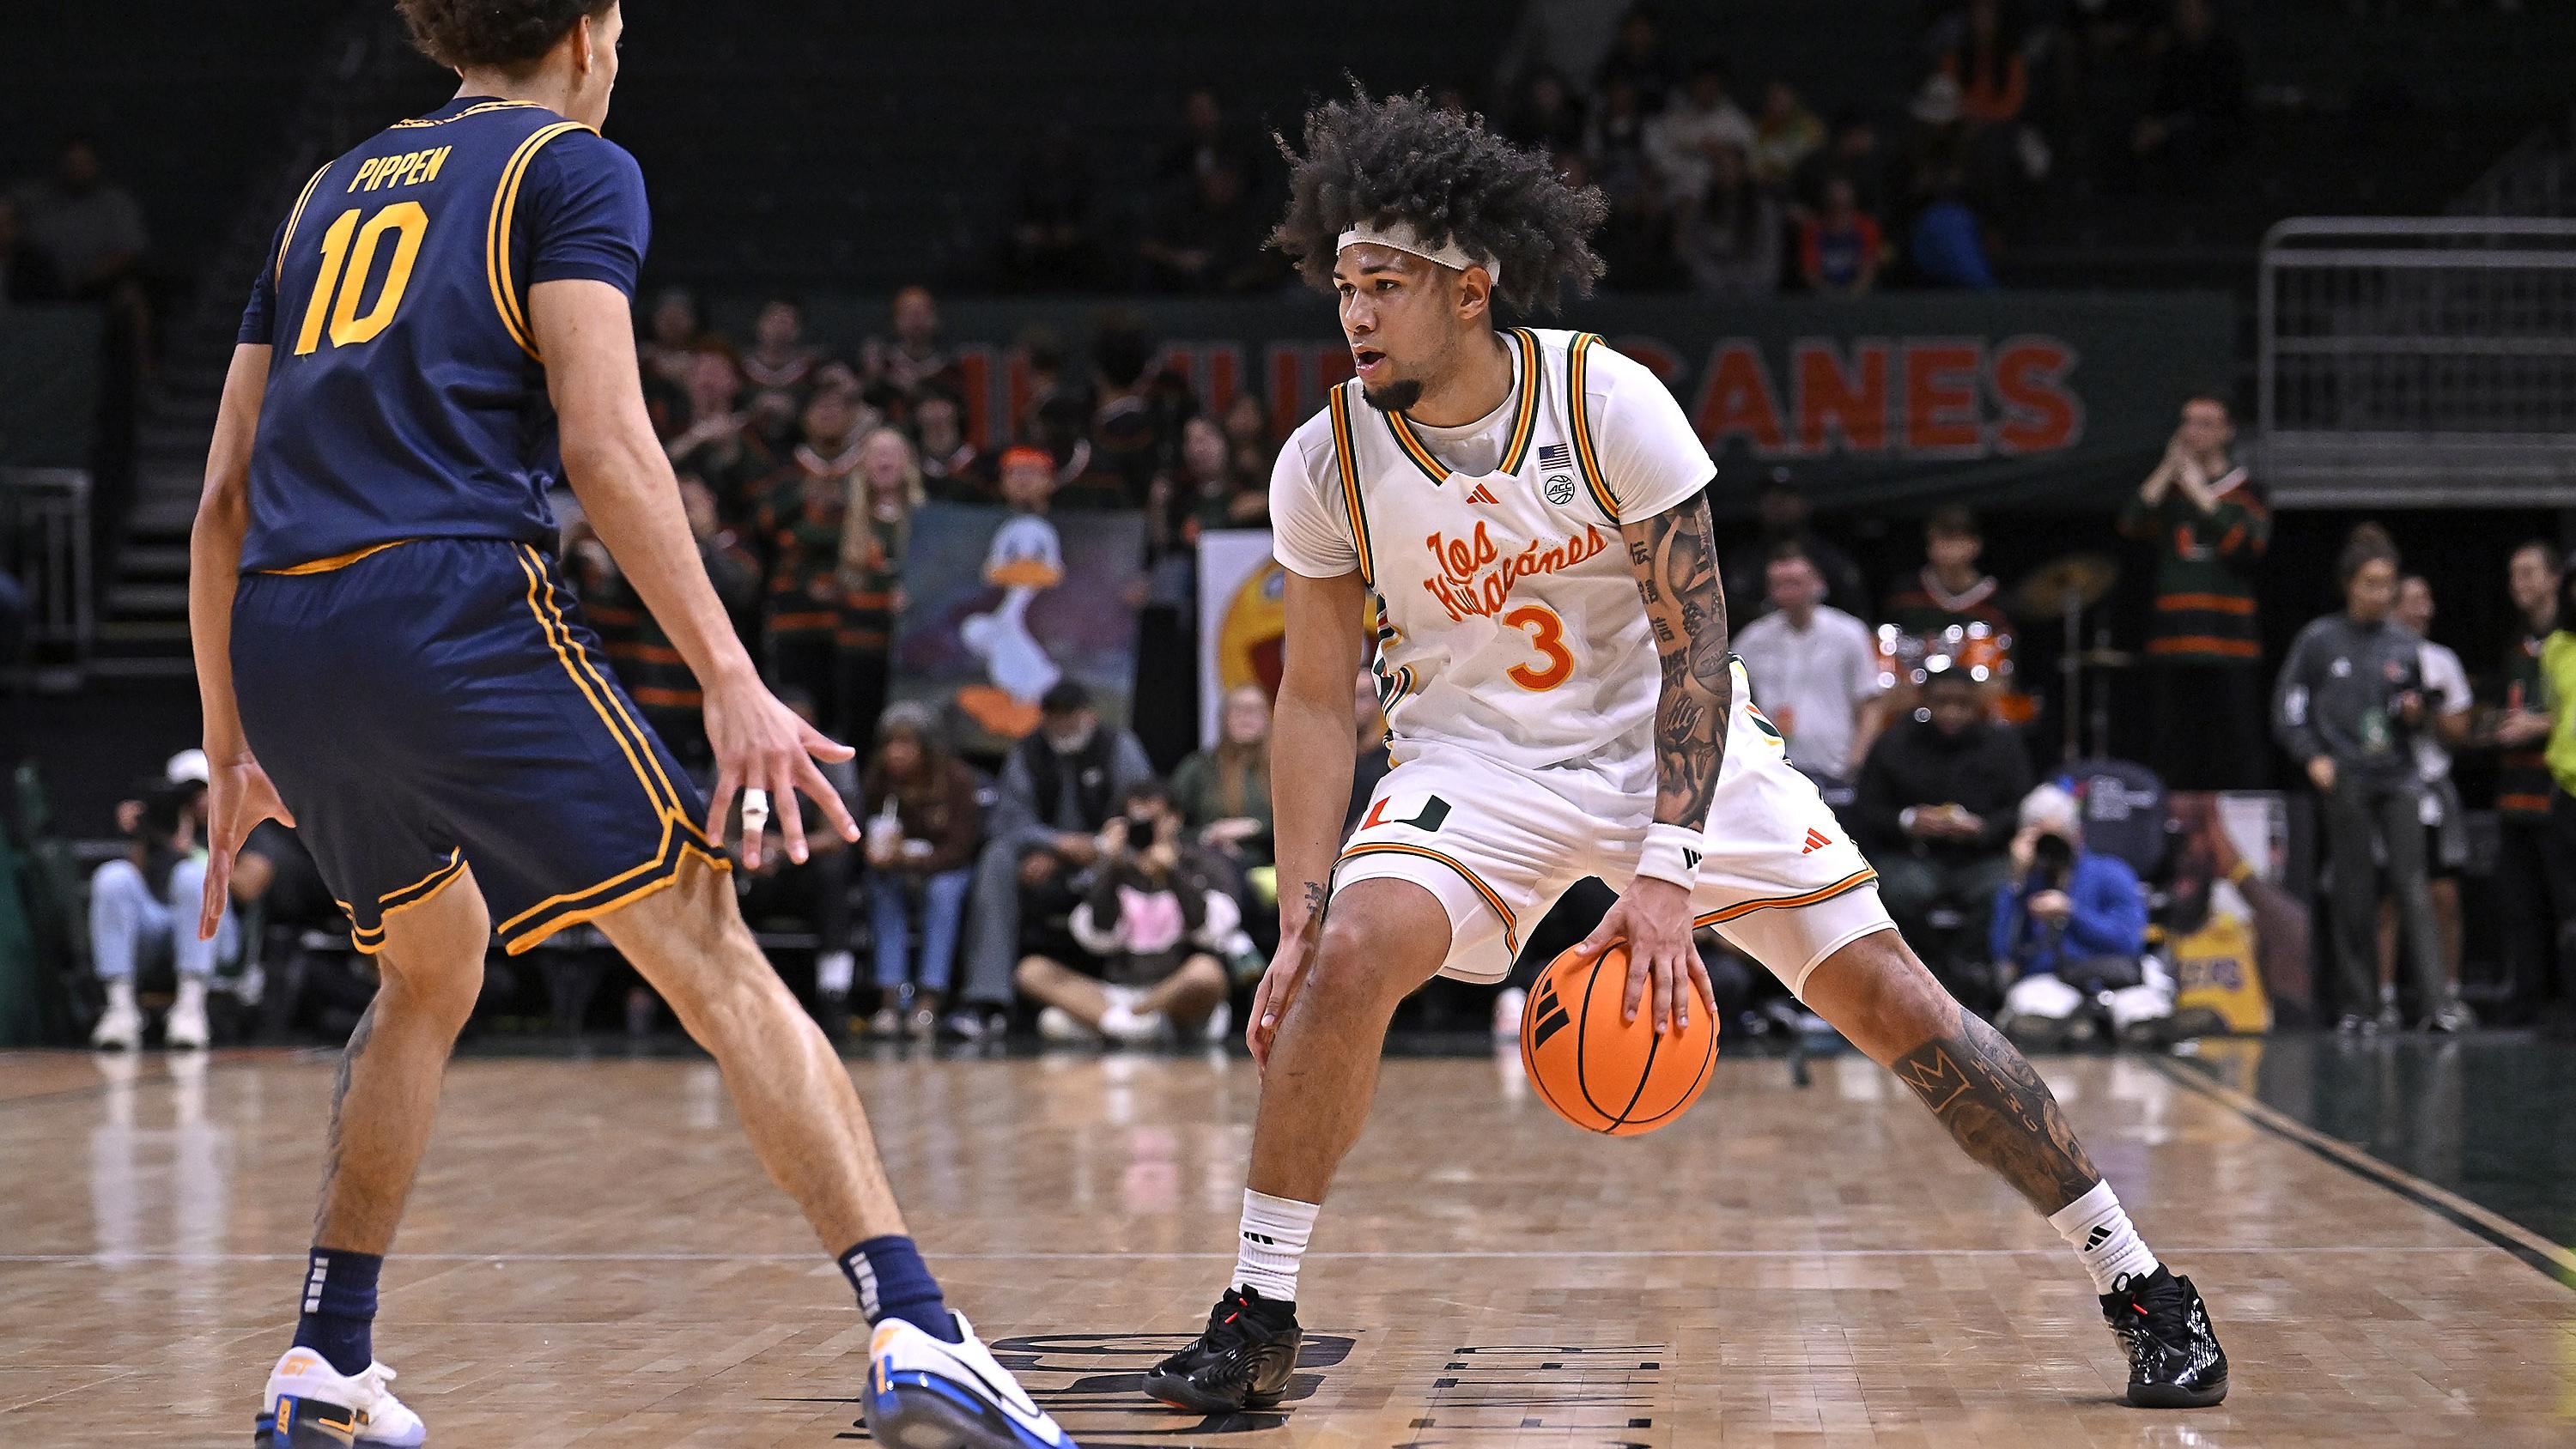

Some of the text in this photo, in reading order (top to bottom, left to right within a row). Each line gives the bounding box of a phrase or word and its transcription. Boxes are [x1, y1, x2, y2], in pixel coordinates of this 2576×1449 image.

[347, 145, 453, 193] PIPPEN
[294, 201, 429, 356] 10
[1502, 604, 1575, 692] 3
